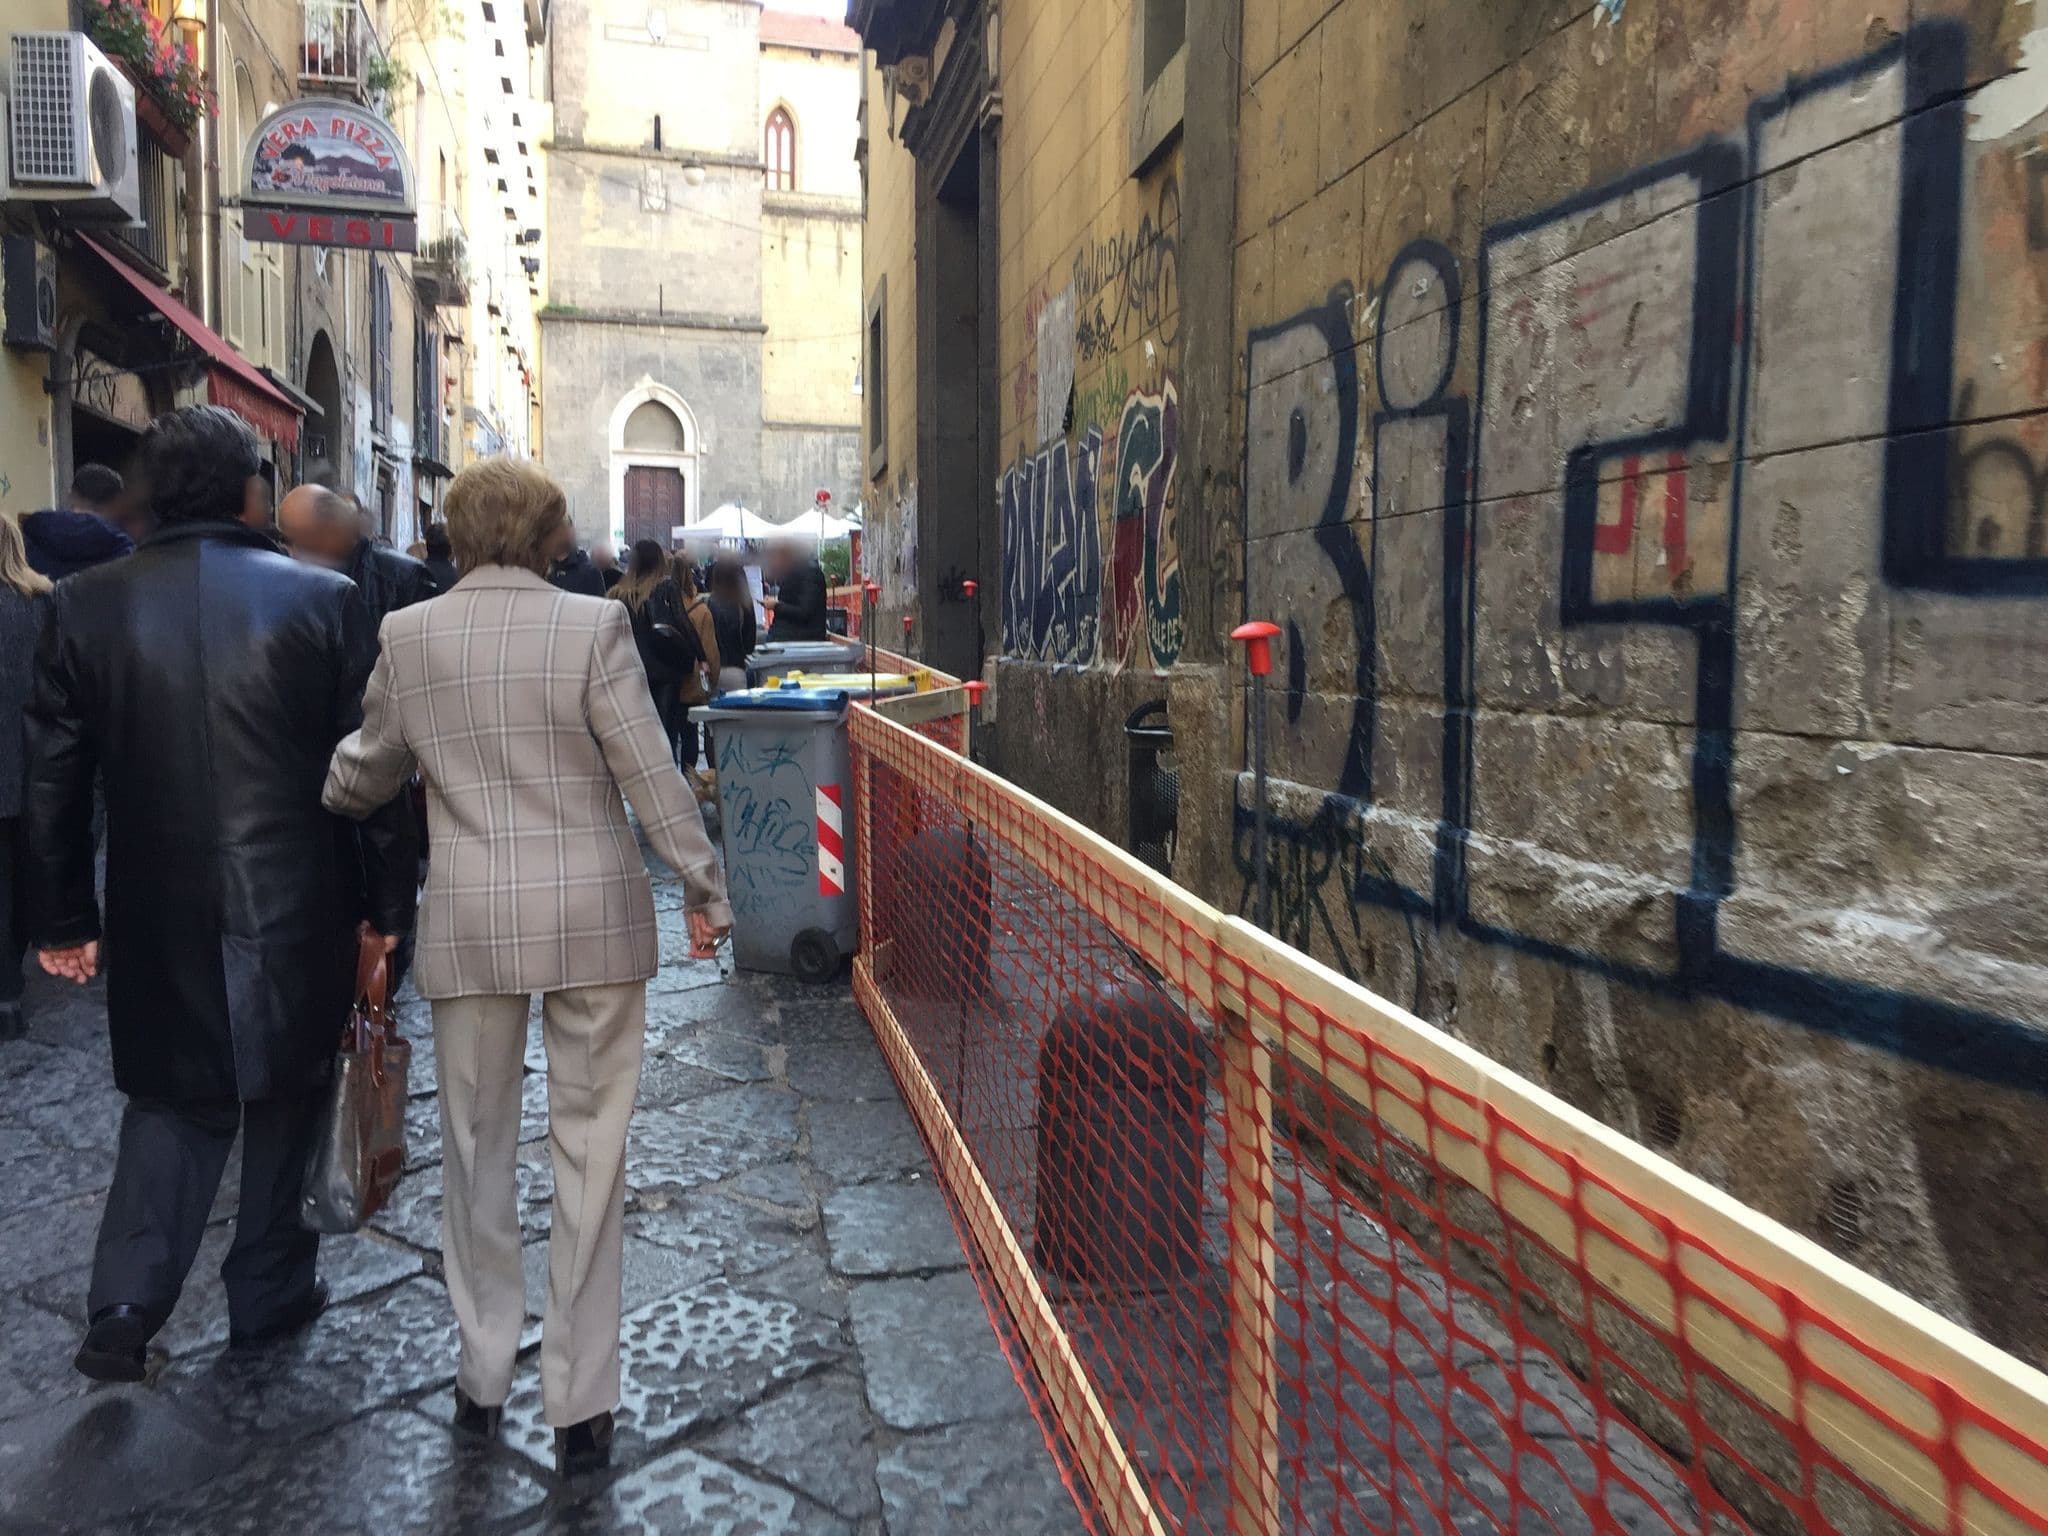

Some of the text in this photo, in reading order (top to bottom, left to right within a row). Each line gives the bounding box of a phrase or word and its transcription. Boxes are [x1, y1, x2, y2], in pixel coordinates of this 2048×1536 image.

[262, 116, 393, 171] VERA PIZZA
[267, 213, 393, 246] VESI
